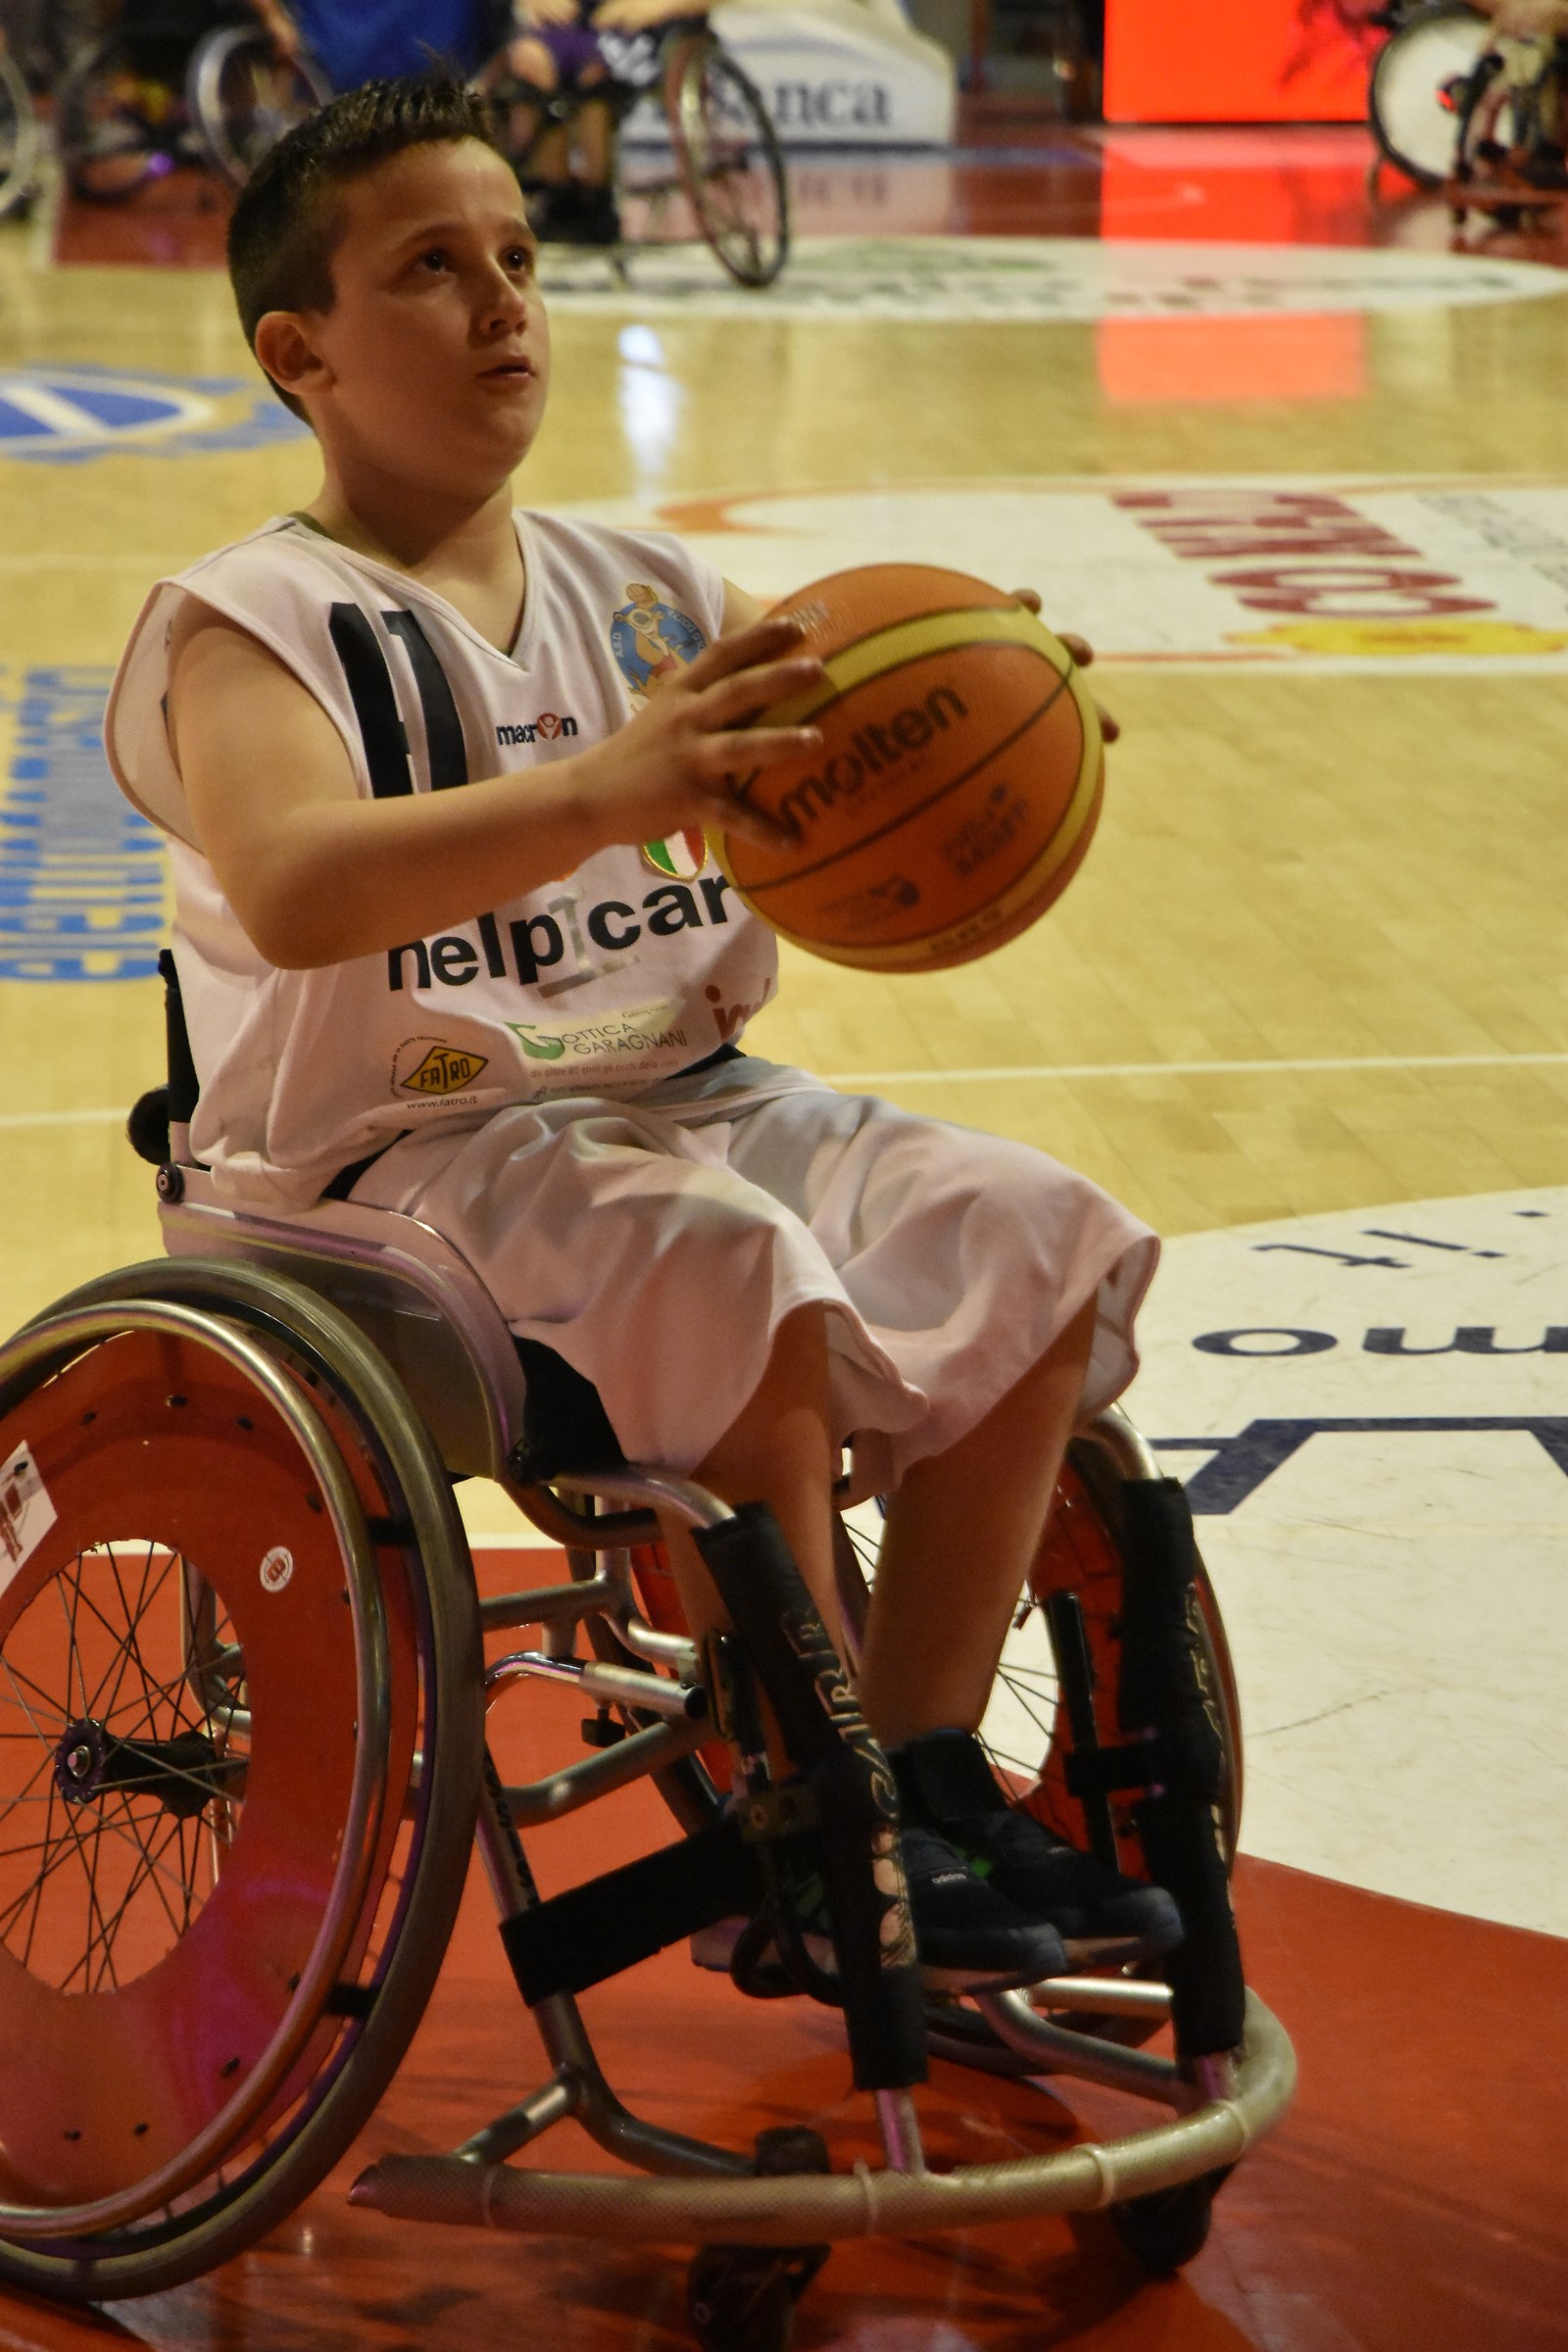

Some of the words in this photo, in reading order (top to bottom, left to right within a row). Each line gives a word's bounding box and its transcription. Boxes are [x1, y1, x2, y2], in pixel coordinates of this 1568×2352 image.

[497, 712, 577, 746] macron
[779, 685, 968, 833] molten
[562, 1022, 637, 1045] OTTICA
[573, 1029, 688, 1055] GARAGNANI
[419, 1053, 471, 1090] FATRO
[407, 1095, 478, 1109] www.fatro.it
